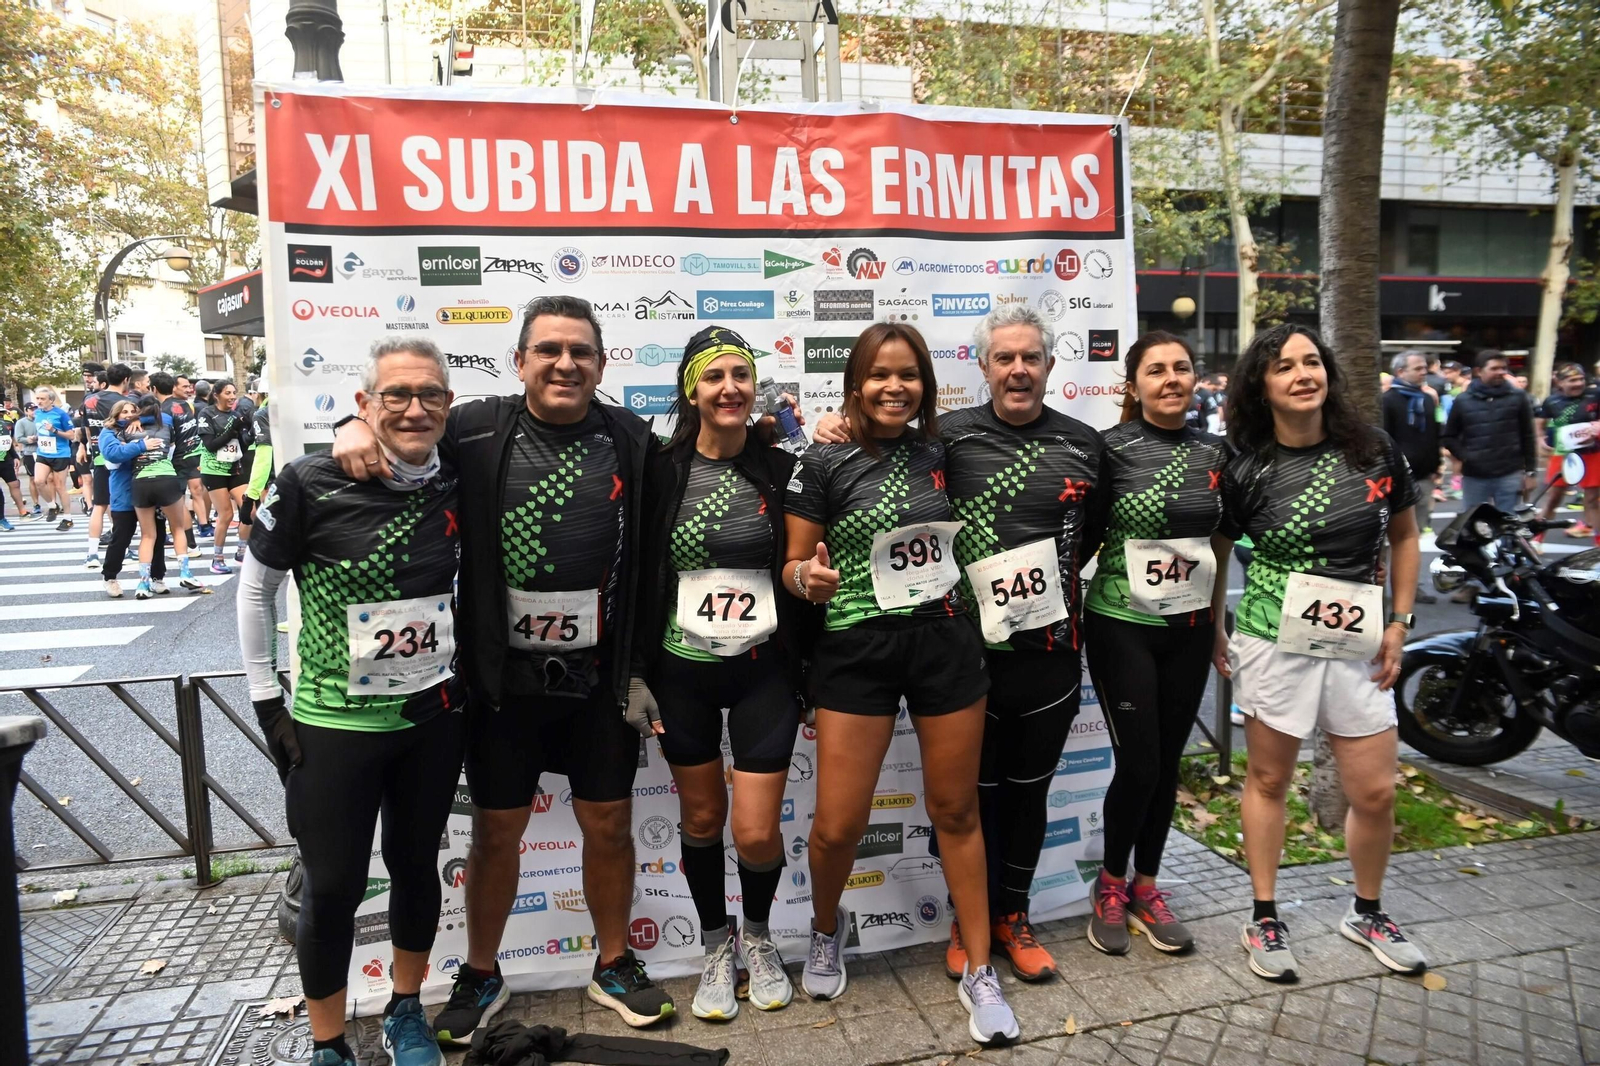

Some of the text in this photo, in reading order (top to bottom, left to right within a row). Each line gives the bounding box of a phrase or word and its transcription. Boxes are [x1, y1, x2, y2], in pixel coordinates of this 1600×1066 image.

[305, 133, 1099, 220] XI SUBIDA A LAS ERMITAS
[562, 248, 584, 259] SUPER
[611, 255, 675, 268] IMDECO
[918, 262, 984, 274] AGROMÉTODOS
[985, 252, 1053, 275] acuerdo
[362, 267, 404, 278] gayro
[217, 293, 244, 317] cajasur
[738, 300, 765, 309] Couñago
[878, 299, 928, 307] SAGACOR
[934, 297, 989, 311] PINVECO
[996, 293, 1028, 305] Sabor
[1069, 297, 1091, 309] SIG
[317, 305, 380, 318] VEOLIA
[594, 302, 630, 312] MAI
[451, 311, 509, 320] EL QUIJOTE
[386, 322, 430, 330] MASTERNATURA
[446, 352, 496, 369] appas
[938, 383, 967, 396] abor
[1079, 385, 1120, 396] VEOLIA
[303, 421, 335, 430] MASTERNA
[1062, 439, 1089, 462] IMDECO
[889, 534, 942, 572] 598
[1146, 557, 1200, 586] 547
[990, 567, 1047, 607] 548
[696, 592, 757, 622] 472
[1301, 599, 1366, 634] 432
[513, 613, 579, 642] 475
[373, 621, 439, 661] 234
[877, 797, 914, 807] QUIJOTE
[528, 840, 577, 851] VEOLIA
[518, 865, 583, 879] AGROMÉTOD
[552, 888, 584, 900] Sabo
[645, 888, 669, 898] SIG
[512, 895, 545, 909] VECO
[786, 895, 812, 905] MASTERNA
[360, 922, 389, 934] REFORMA
[770, 927, 798, 940] ayro
[546, 934, 597, 955] acuer
[495, 945, 545, 961] MÉTODOS
